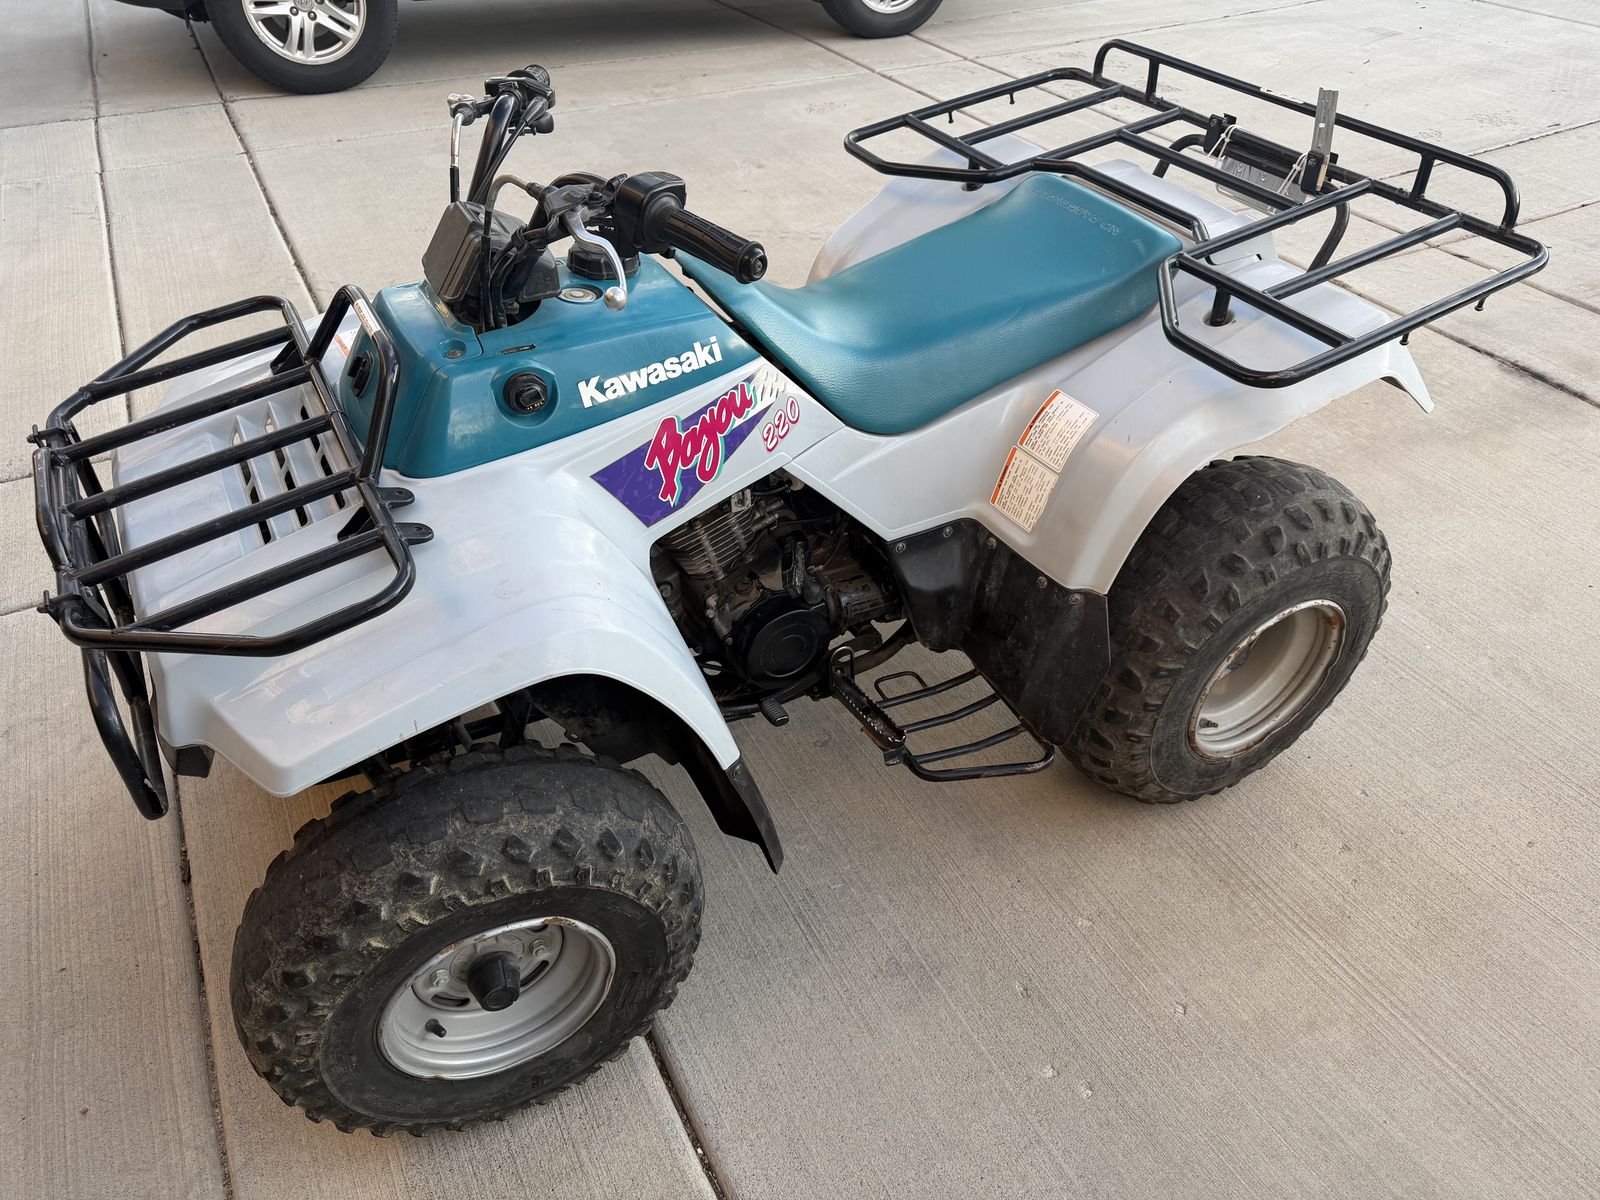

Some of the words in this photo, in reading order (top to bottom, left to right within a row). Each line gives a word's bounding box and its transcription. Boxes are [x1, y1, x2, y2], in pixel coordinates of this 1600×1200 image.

[577, 335, 723, 409] Kawasaki
[644, 382, 757, 508] Bayou
[763, 396, 800, 452] 220
